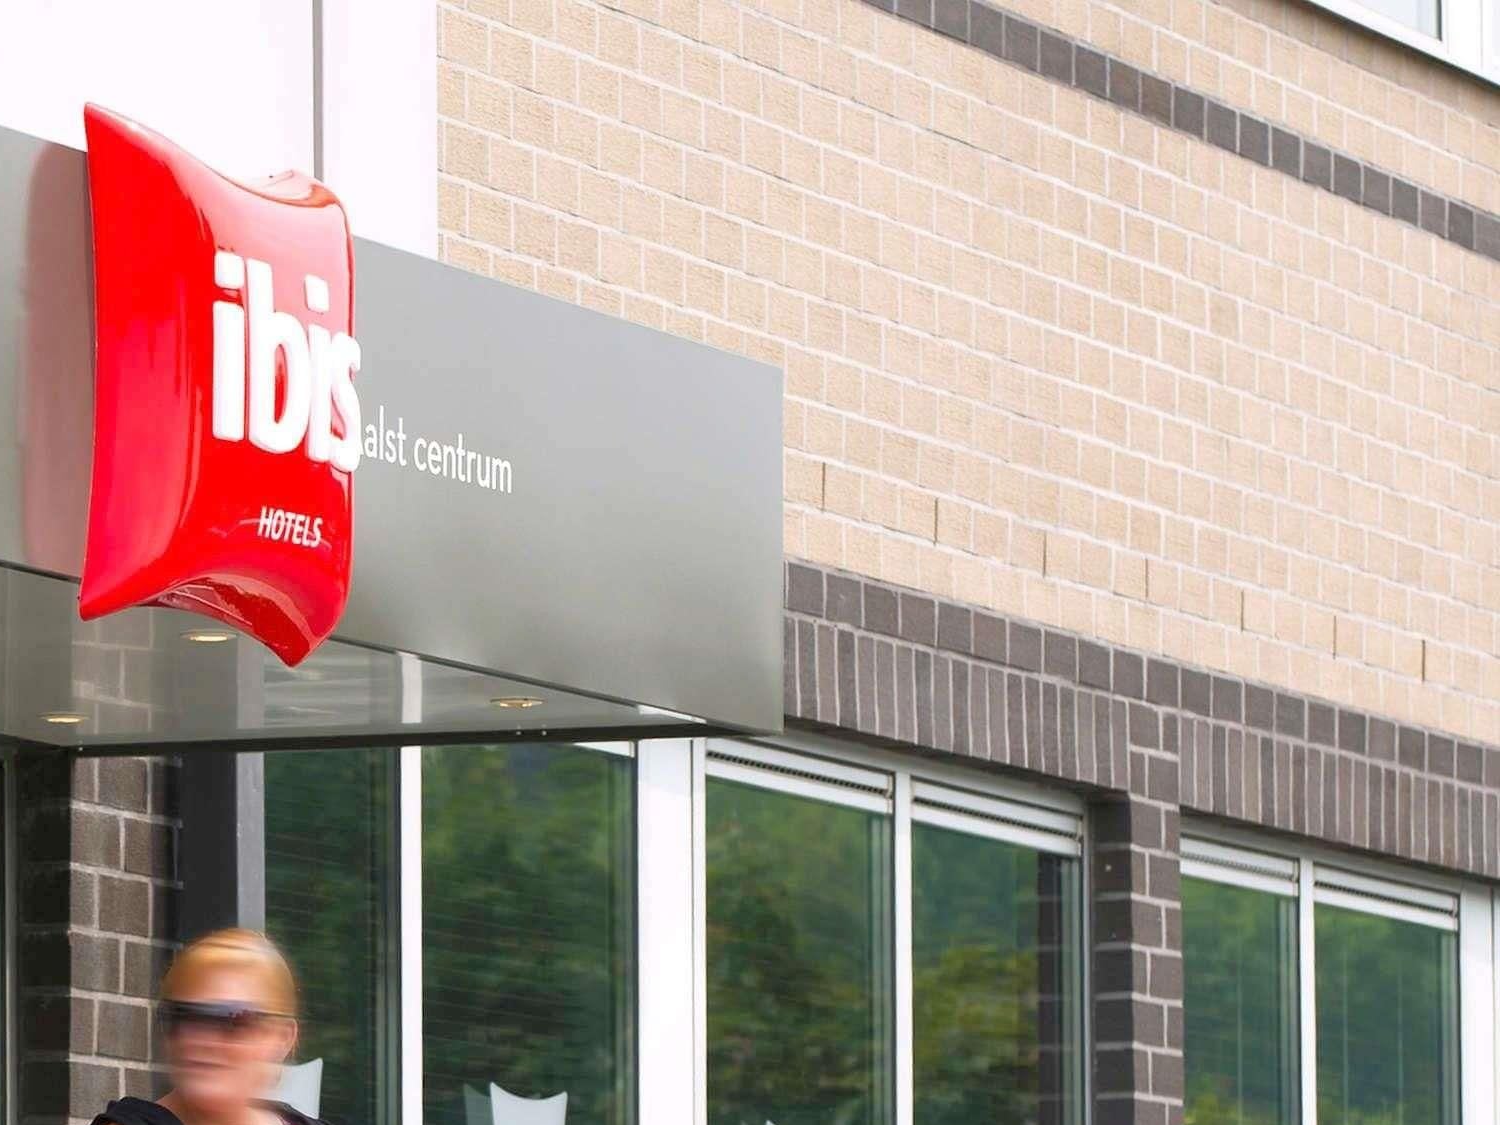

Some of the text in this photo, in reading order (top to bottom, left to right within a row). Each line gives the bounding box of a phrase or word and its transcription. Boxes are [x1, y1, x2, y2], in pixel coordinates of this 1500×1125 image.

[212, 250, 361, 473] ibis
[359, 404, 513, 494] alst centrum
[257, 506, 324, 548] HOTELS
